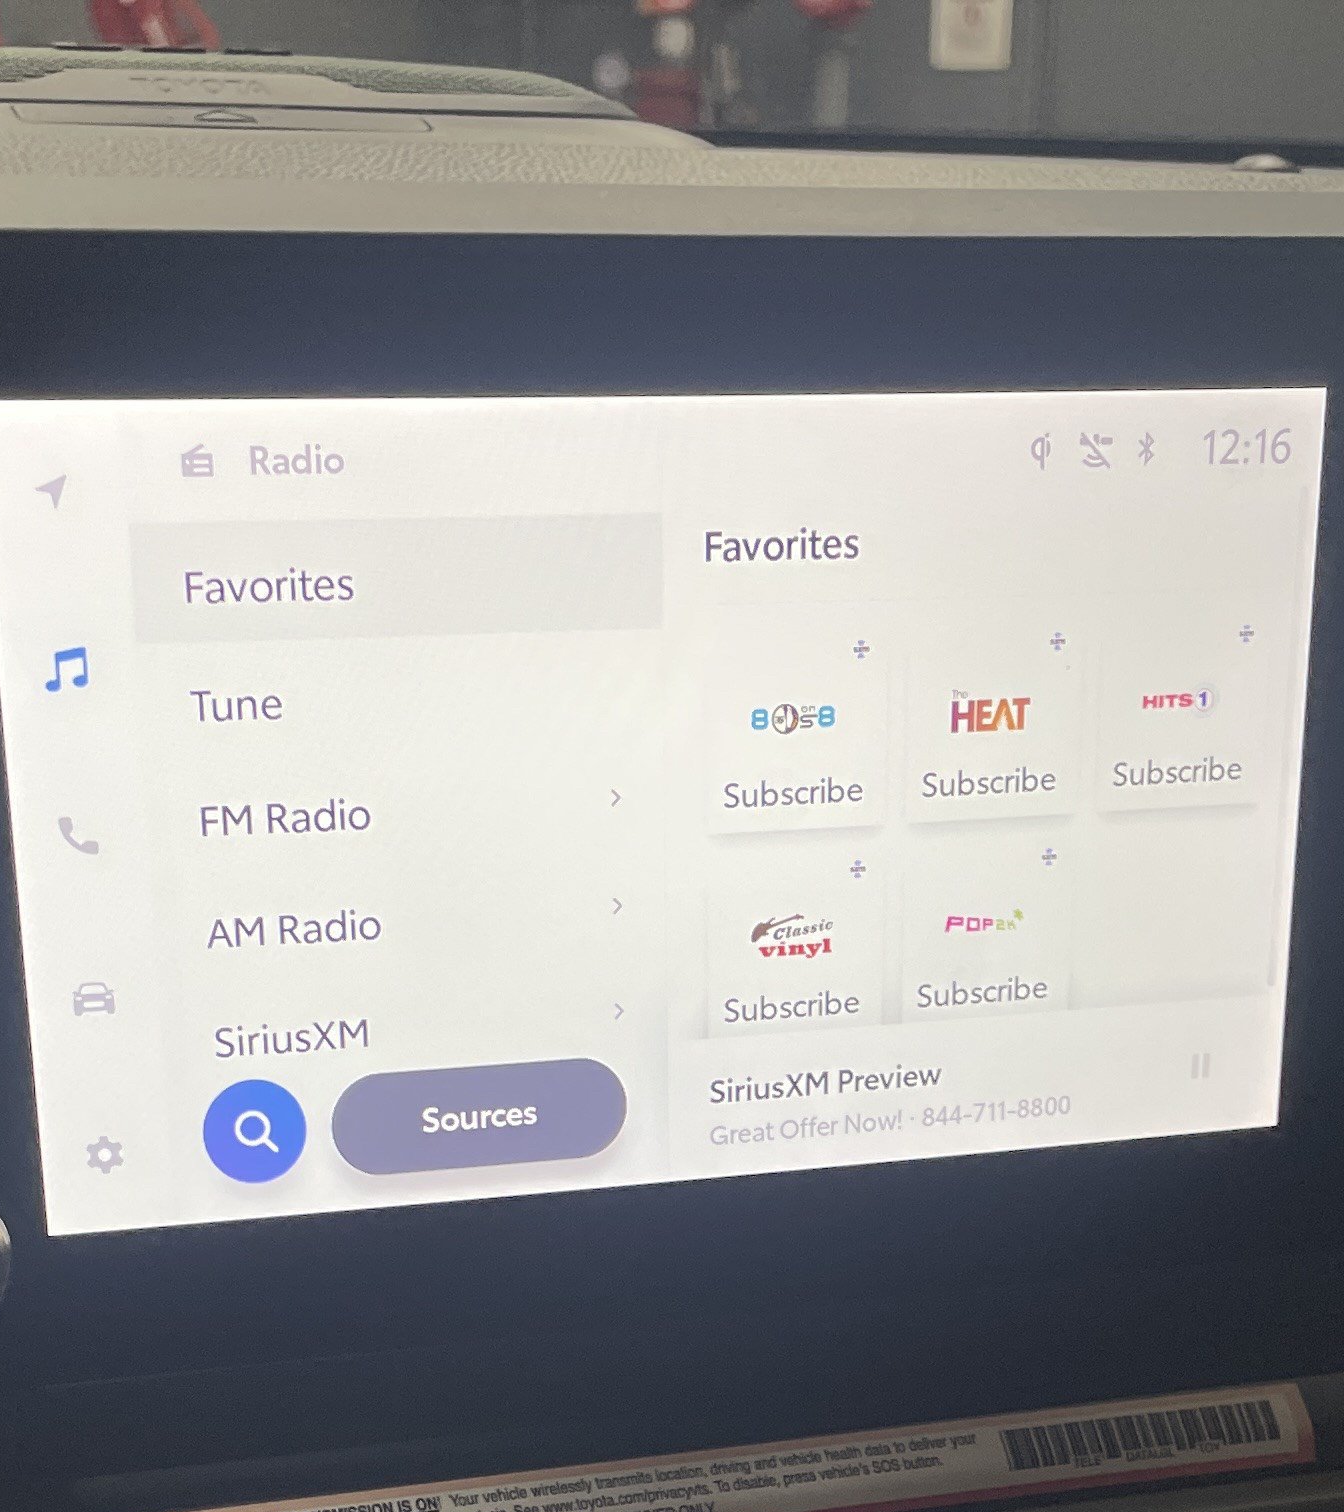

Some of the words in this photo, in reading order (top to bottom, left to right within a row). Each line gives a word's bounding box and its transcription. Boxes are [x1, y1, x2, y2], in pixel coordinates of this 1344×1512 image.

[129, 75, 271, 96] TOYOTA
[248, 443, 346, 476] Radio
[1202, 428, 1292, 466] 12:16
[704, 526, 860, 564] Favorites
[184, 567, 355, 604] Favorites
[189, 689, 284, 723] Tune
[951, 697, 1031, 733] HEAT
[1141, 693, 1194, 709] HITS
[1198, 691, 1208, 707] 1
[920, 766, 1057, 800] Subscribe
[1112, 757, 1243, 789] Subscribe
[722, 777, 864, 810] Subscribe
[199, 804, 253, 838] FM
[267, 798, 372, 835] Radio
[206, 917, 266, 950] AM
[278, 909, 382, 946] Radio
[773, 918, 834, 940] Classic
[758, 938, 832, 959] vinyl
[722, 990, 860, 1024] Subscribe
[916, 975, 1049, 1010] Subscribe
[213, 1019, 371, 1059] SiriusXM
[709, 1071, 830, 1105] SiriusXM
[837, 1063, 942, 1096] Preview
[421, 1103, 538, 1135] Sources
[709, 1120, 775, 1147] Great
[779, 1114, 838, 1140] Offer
[843, 1110, 904, 1135] Now!
[920, 1094, 1072, 1129] 844-711-8800
[449, 1491, 479, 1507] Your
[482, 1488, 527, 1503] vehicle
[530, 1478, 592, 1499] wirelessly
[596, 1472, 653, 1489] transmits
[655, 1465, 708, 1483] location,
[710, 1459, 751, 1477] driving
[755, 1455, 777, 1470] and
[781, 1450, 821, 1467] vehicle
[824, 1446, 861, 1462] health
[864, 1442, 891, 1457] data
[893, 1440, 906, 1454] to
[909, 1436, 947, 1453] deliver
[949, 1433, 977, 1450] your
[714, 1480, 730, 1494] To
[733, 1474, 780, 1491] disable,
[783, 1471, 817, 1487] press
[819, 1462, 870, 1481] vehicle's
[872, 1459, 901, 1474] SOS
[903, 1454, 943, 1471] button.
